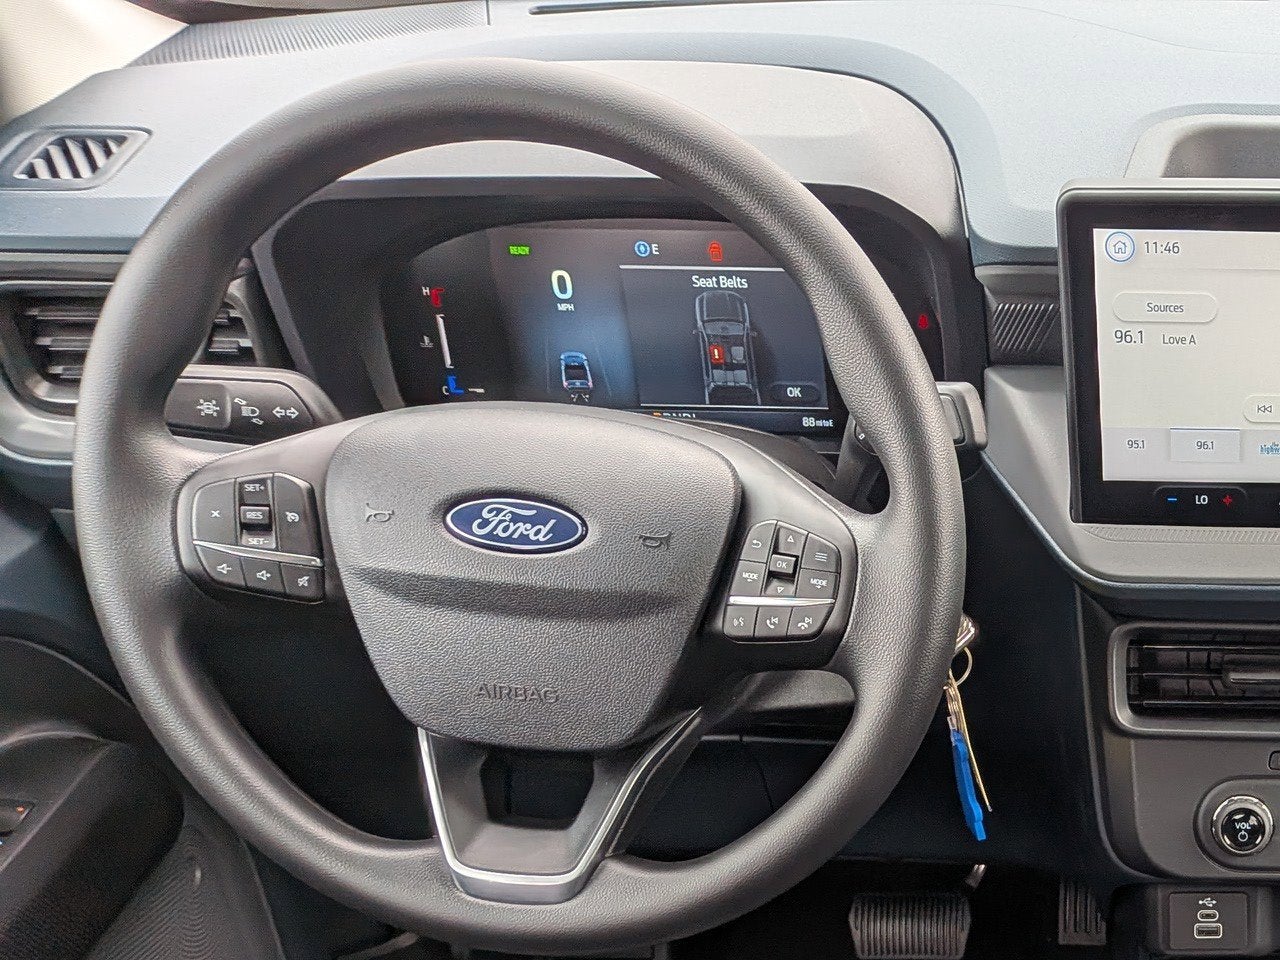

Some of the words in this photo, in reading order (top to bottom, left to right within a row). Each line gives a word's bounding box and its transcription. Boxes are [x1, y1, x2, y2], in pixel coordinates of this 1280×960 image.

[509, 246, 530, 255] READY
[652, 244, 660, 255] E
[1144, 241, 1180, 255] 11:46
[551, 269, 574, 300] 0
[691, 275, 717, 289] Seat
[718, 275, 748, 290] Belts
[421, 287, 431, 296] H
[557, 303, 574, 312] MPH
[1146, 302, 1184, 314] Sources
[1114, 329, 1144, 345] 96.1
[1162, 334, 1187, 346] Love
[1189, 334, 1196, 346] A
[786, 386, 803, 398] OK
[802, 416, 815, 427] 88
[1127, 439, 1145, 450] 95.1
[1196, 440, 1215, 451] 96.1
[245, 484, 265, 492] SET+
[1195, 495, 1208, 505] LO
[246, 511, 263, 520] RES
[472, 504, 556, 543] Ford
[776, 560, 788, 568] OK
[810, 578, 828, 586] MODE
[474, 683, 559, 703] AIRBAG
[1235, 822, 1252, 830] VOL
